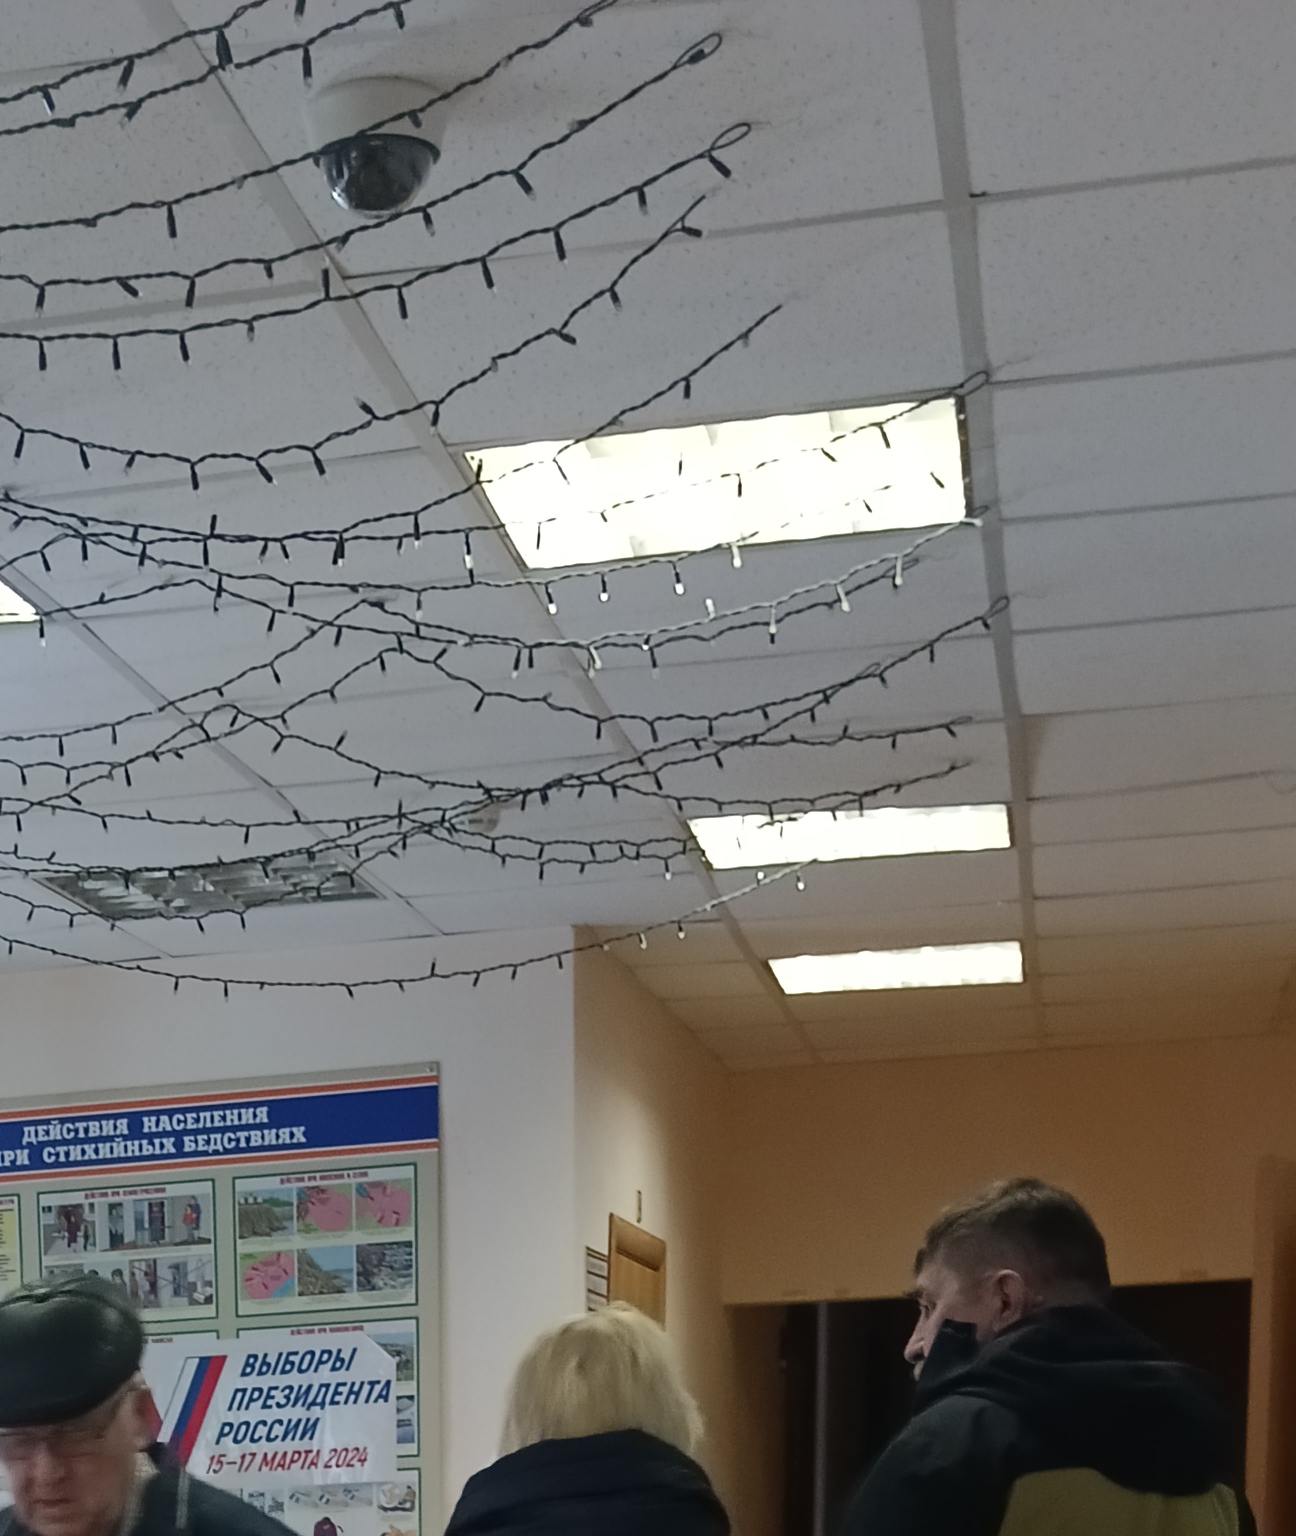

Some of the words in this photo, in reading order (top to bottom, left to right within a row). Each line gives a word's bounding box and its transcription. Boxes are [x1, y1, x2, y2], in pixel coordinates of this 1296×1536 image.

[22, 1117, 129, 1145] ДЕЙСТВИЯ
[142, 1106, 269, 1133] НАСЕЛЕНИЯ
[42, 1138, 177, 1164] СТИХИЙНЫХ
[183, 1126, 307, 1154] БЕДСТВИЯХ
[240, 1347, 358, 1378] ВЫБОРЫ
[227, 1379, 392, 1412] ПРЕЗИДЕНТА
[215, 1417, 321, 1446] РОССИИ
[257, 1449, 321, 1472] МАРТА
[323, 1447, 368, 1469] 2024
